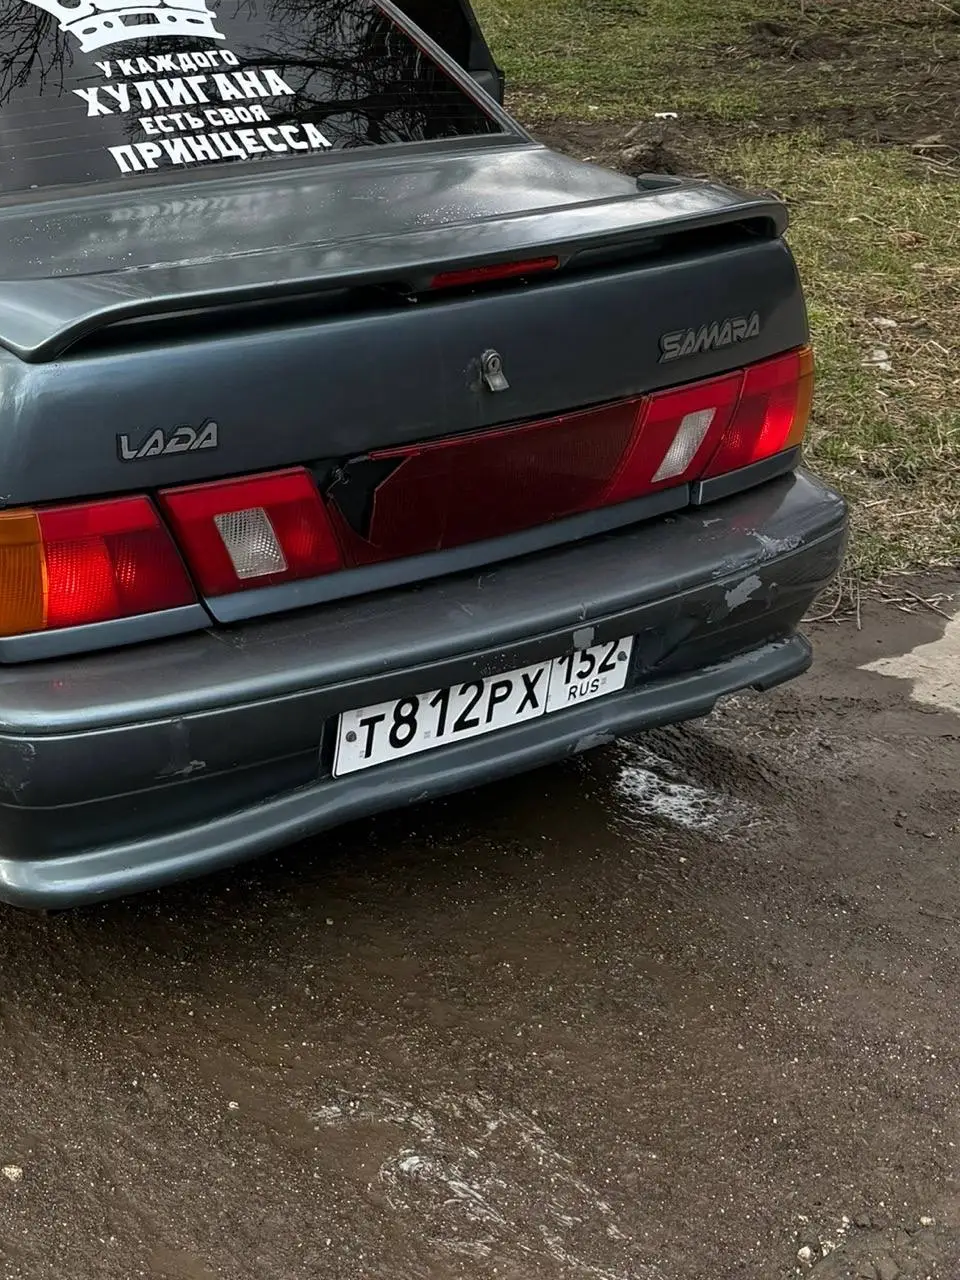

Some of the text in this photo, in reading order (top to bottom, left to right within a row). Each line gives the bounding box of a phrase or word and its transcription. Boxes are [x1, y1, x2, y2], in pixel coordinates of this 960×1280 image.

[95, 49, 240, 78] У КАЖДОГО
[72, 69, 296, 117] ХУЛИГАНА
[138, 104, 271, 135] ЕСТЬ СВОЯ
[107, 123, 332, 173] ПРИНЦЕССА
[660, 311, 760, 363] SAMARA
[119, 422, 218, 460] LADA
[557, 641, 618, 684] 152
[567, 678, 600, 702] RUS
